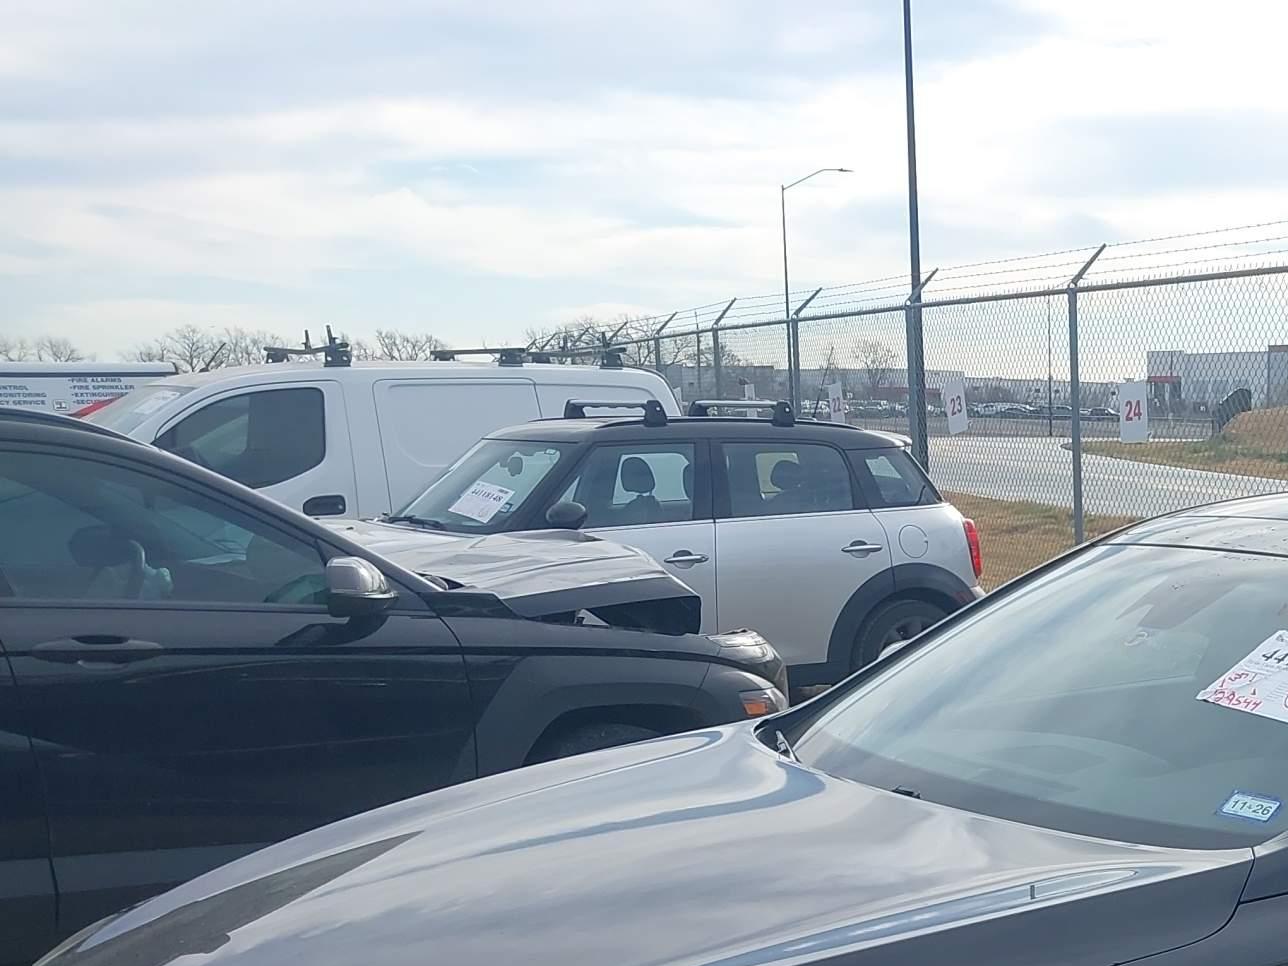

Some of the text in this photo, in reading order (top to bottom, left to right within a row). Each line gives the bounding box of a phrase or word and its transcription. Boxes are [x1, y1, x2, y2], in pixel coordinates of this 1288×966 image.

[950, 395, 963, 416] 23
[1125, 400, 1143, 421] 24
[1252, 803, 1273, 816] 26
